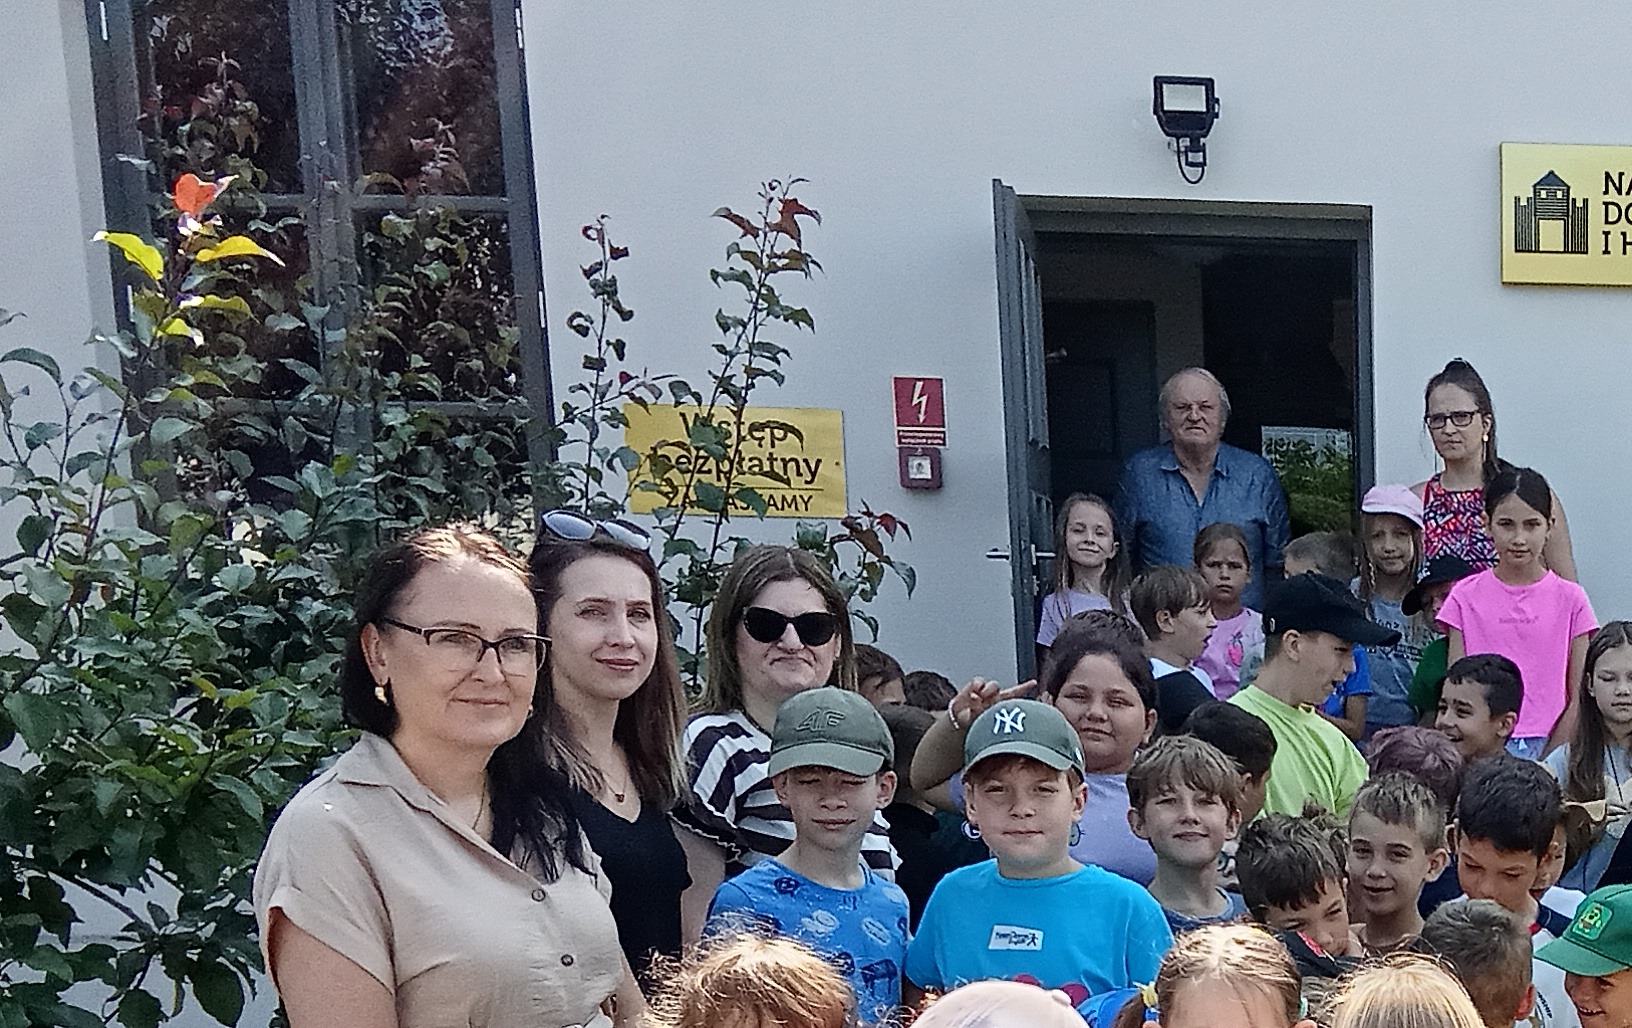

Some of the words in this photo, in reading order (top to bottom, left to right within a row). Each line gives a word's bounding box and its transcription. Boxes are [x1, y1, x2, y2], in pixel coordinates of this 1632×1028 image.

[1602, 231, 1611, 255] I
[652, 447, 823, 484] ezpłatny
[993, 707, 1026, 734] NY
